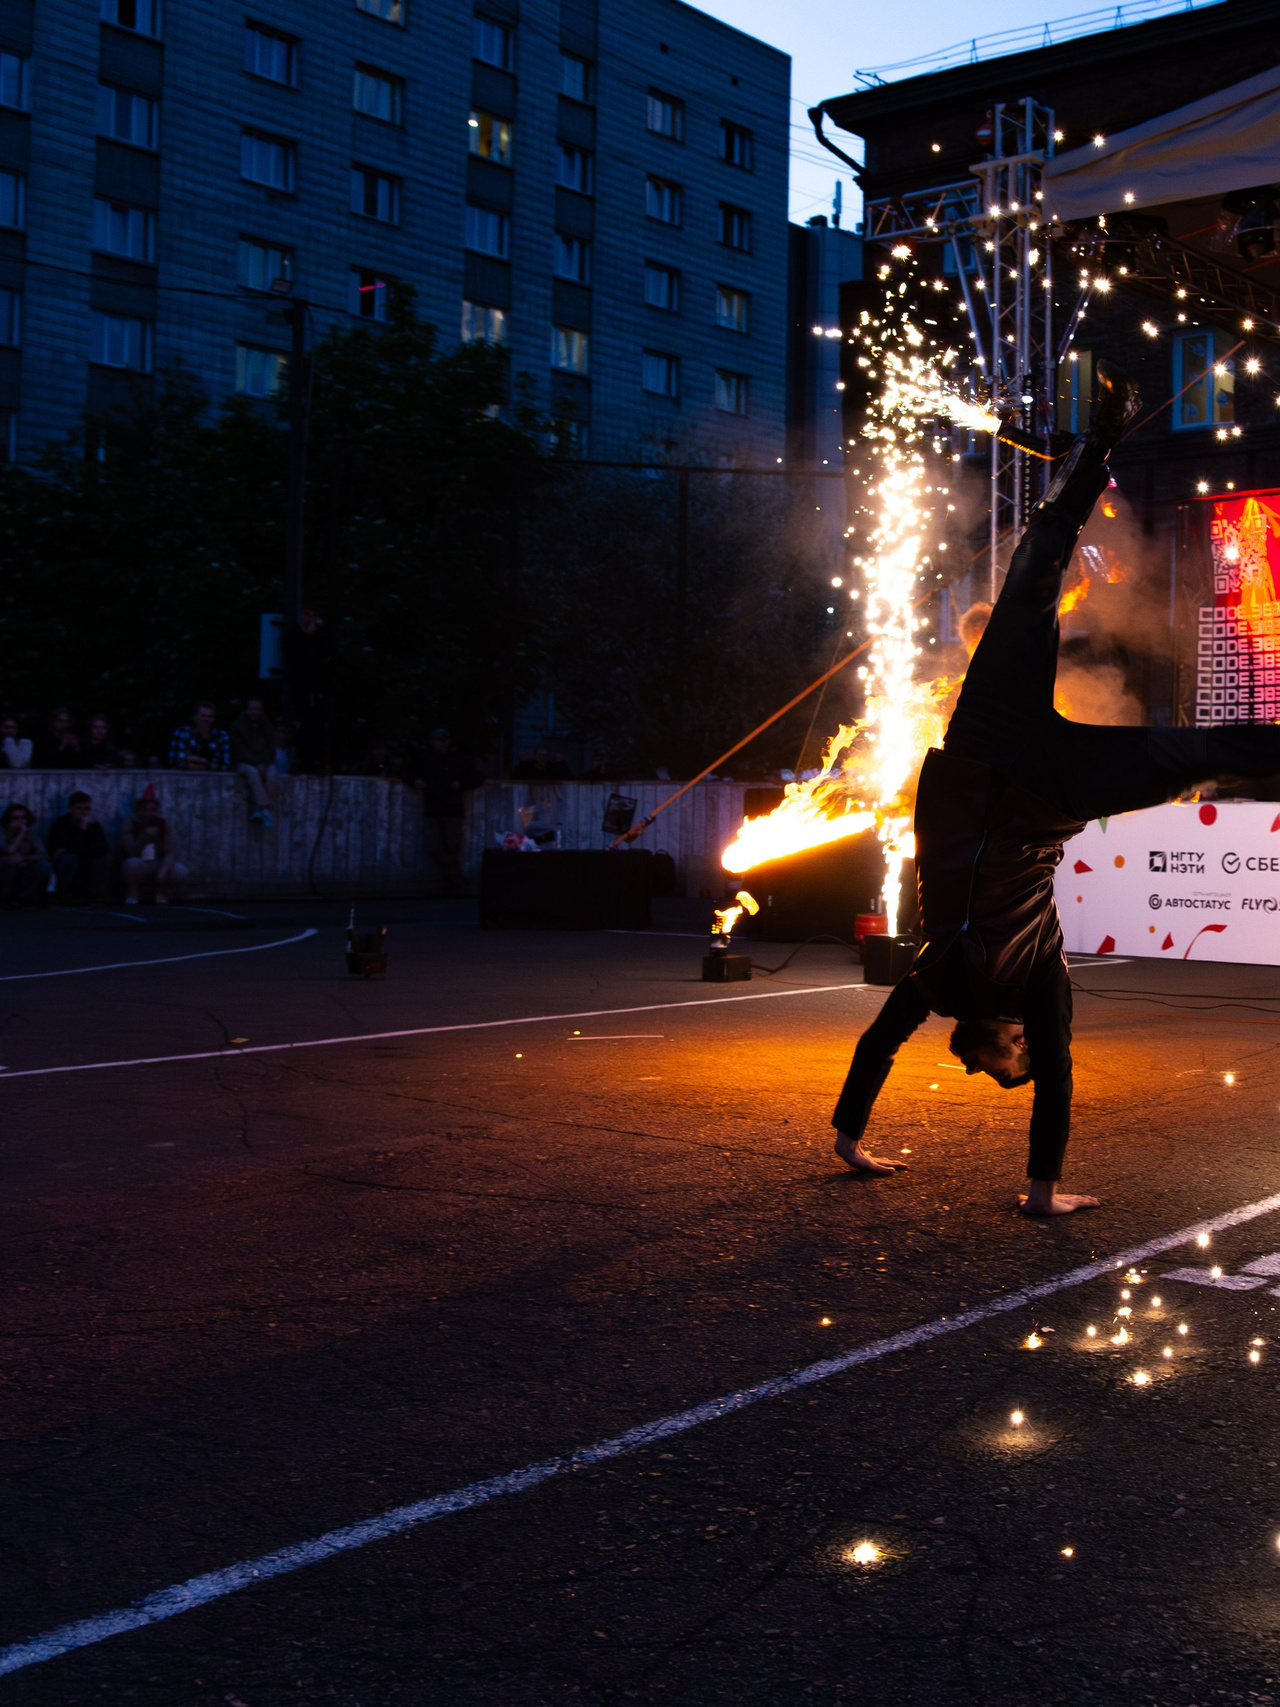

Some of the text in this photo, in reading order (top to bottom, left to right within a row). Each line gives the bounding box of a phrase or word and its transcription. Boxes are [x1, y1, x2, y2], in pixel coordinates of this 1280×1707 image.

[1170, 851, 1205, 862] НГТУ
[1170, 863, 1205, 874] НЭТИ
[1165, 898, 1231, 910] АВТОСТАТУС
